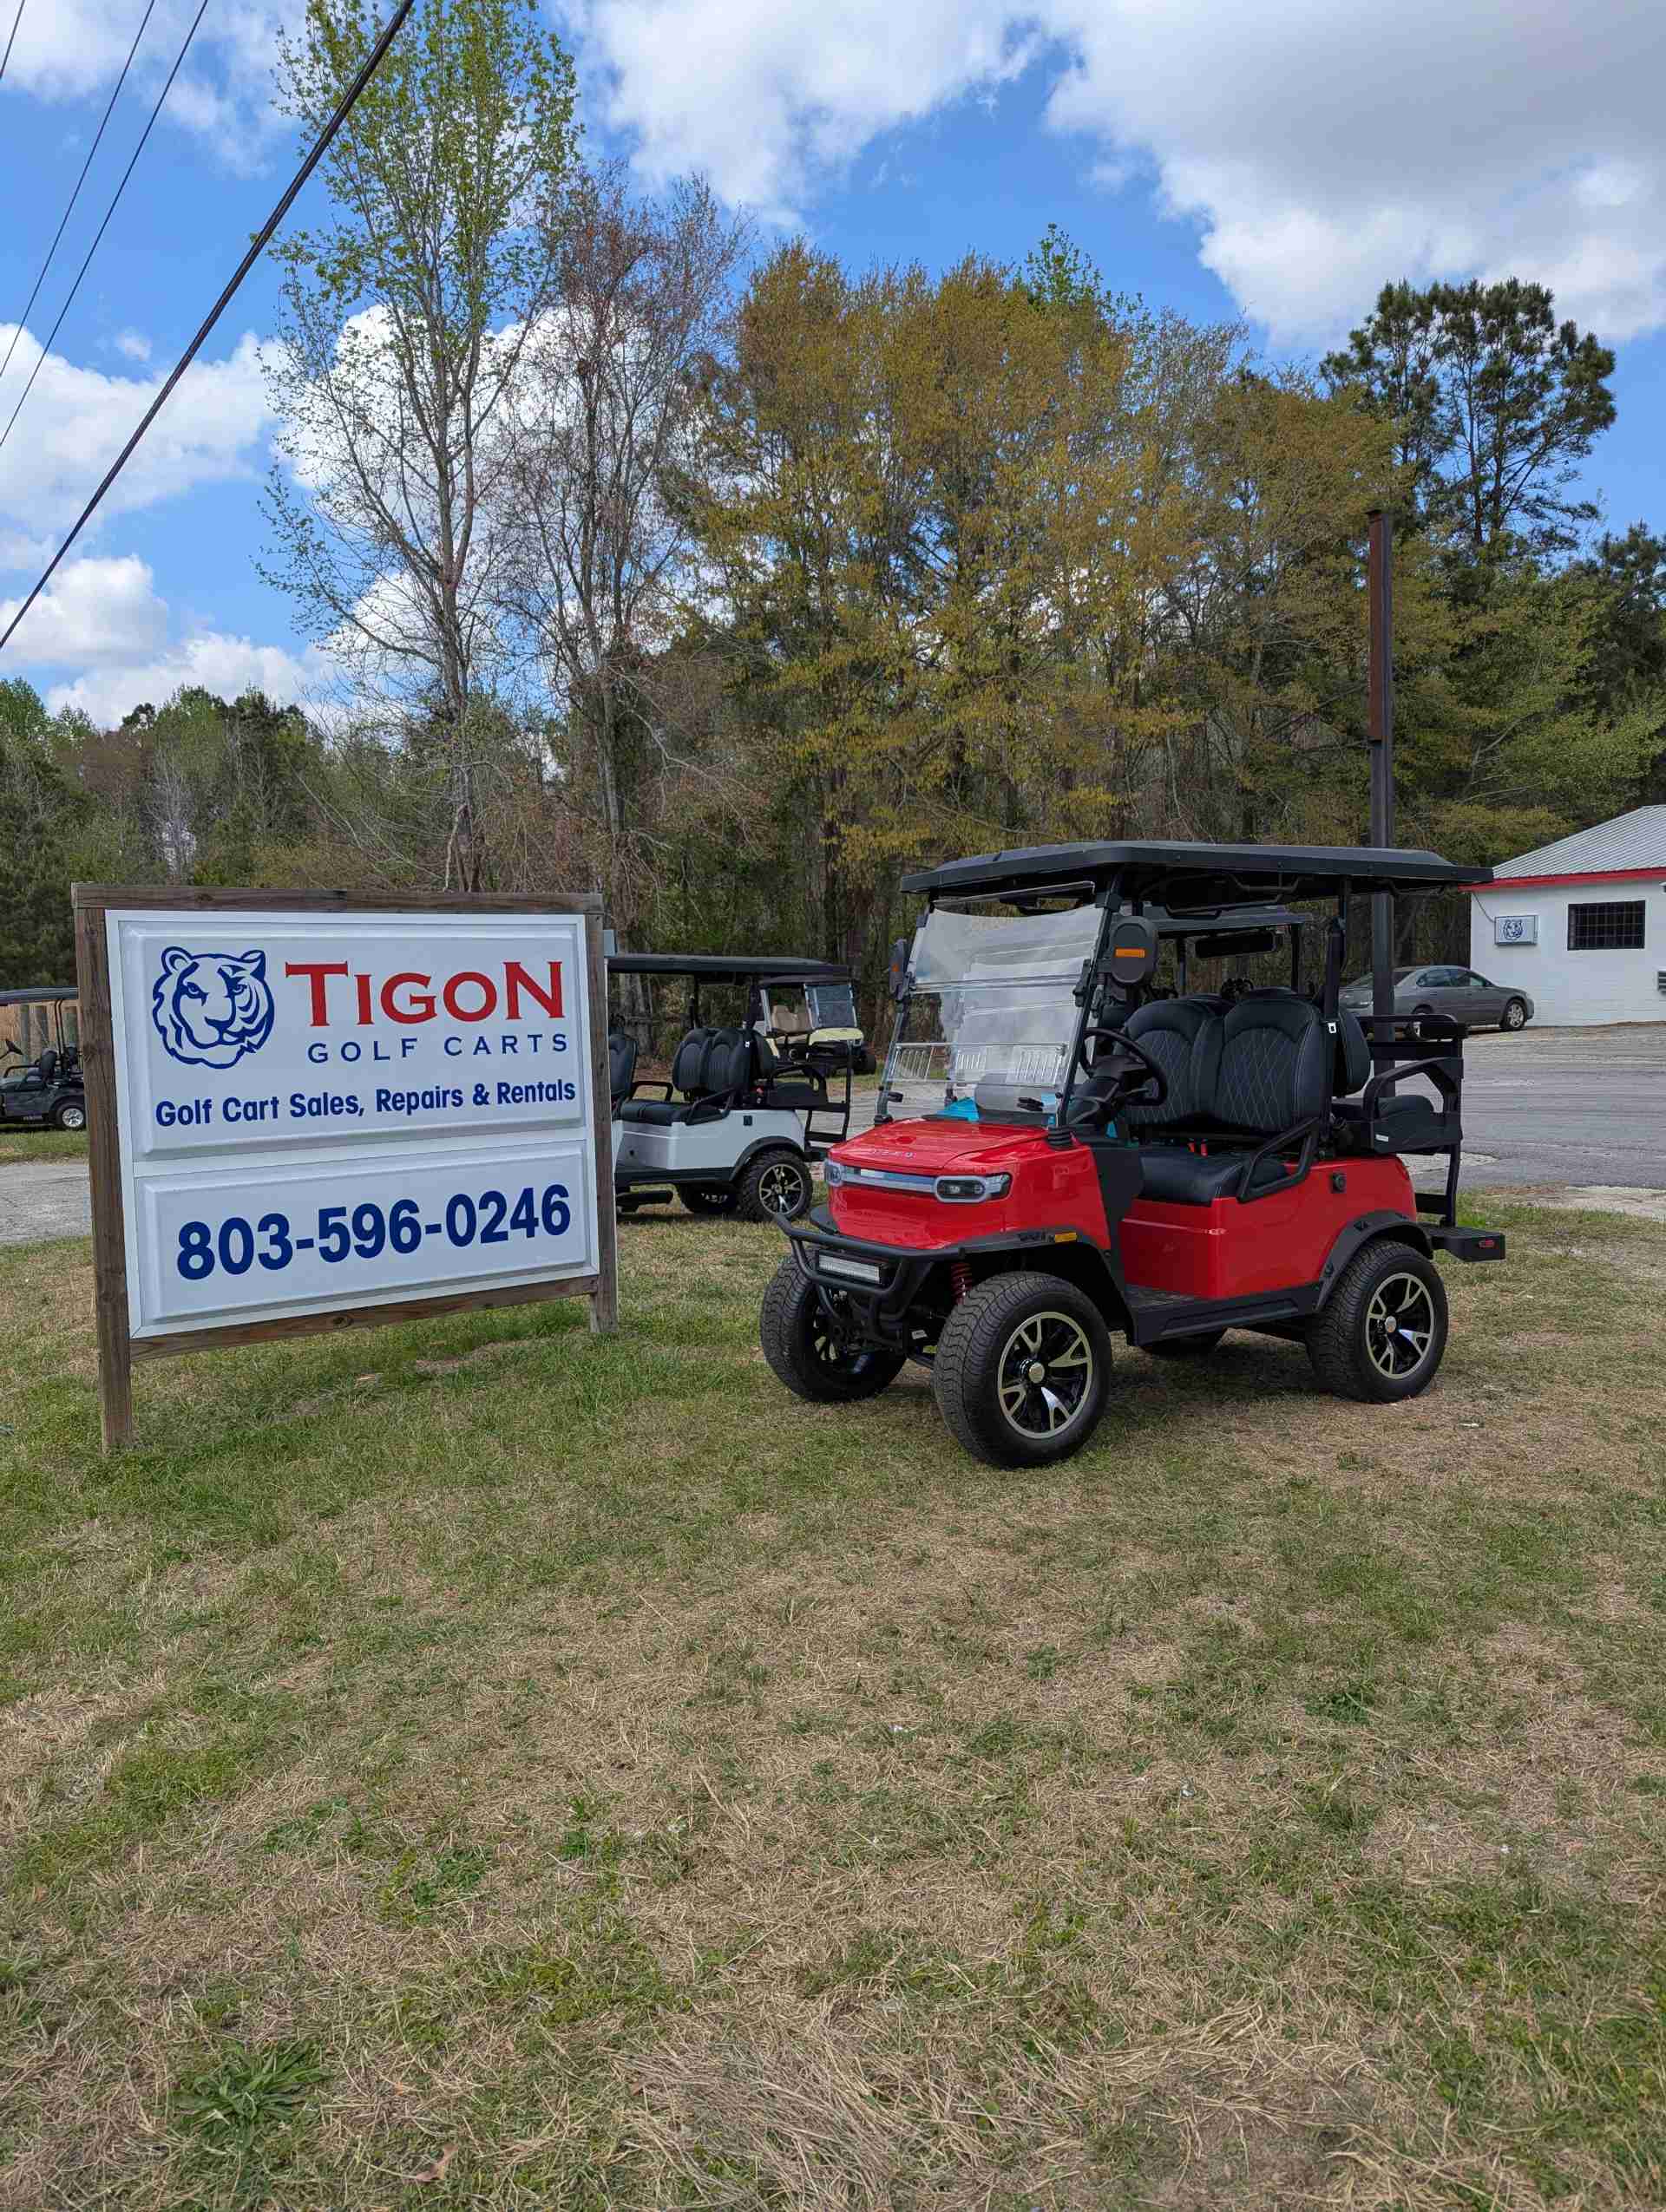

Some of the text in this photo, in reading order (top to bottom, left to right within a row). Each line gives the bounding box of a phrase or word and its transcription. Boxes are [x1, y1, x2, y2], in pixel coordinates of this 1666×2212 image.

[285, 961, 565, 1027] TIGON
[308, 1033, 567, 1063] GOLF CARTS
[156, 1079, 576, 1125] Golf Cart Sales, Repairs & Rentals
[177, 1183, 570, 1280] 803-596-0246
